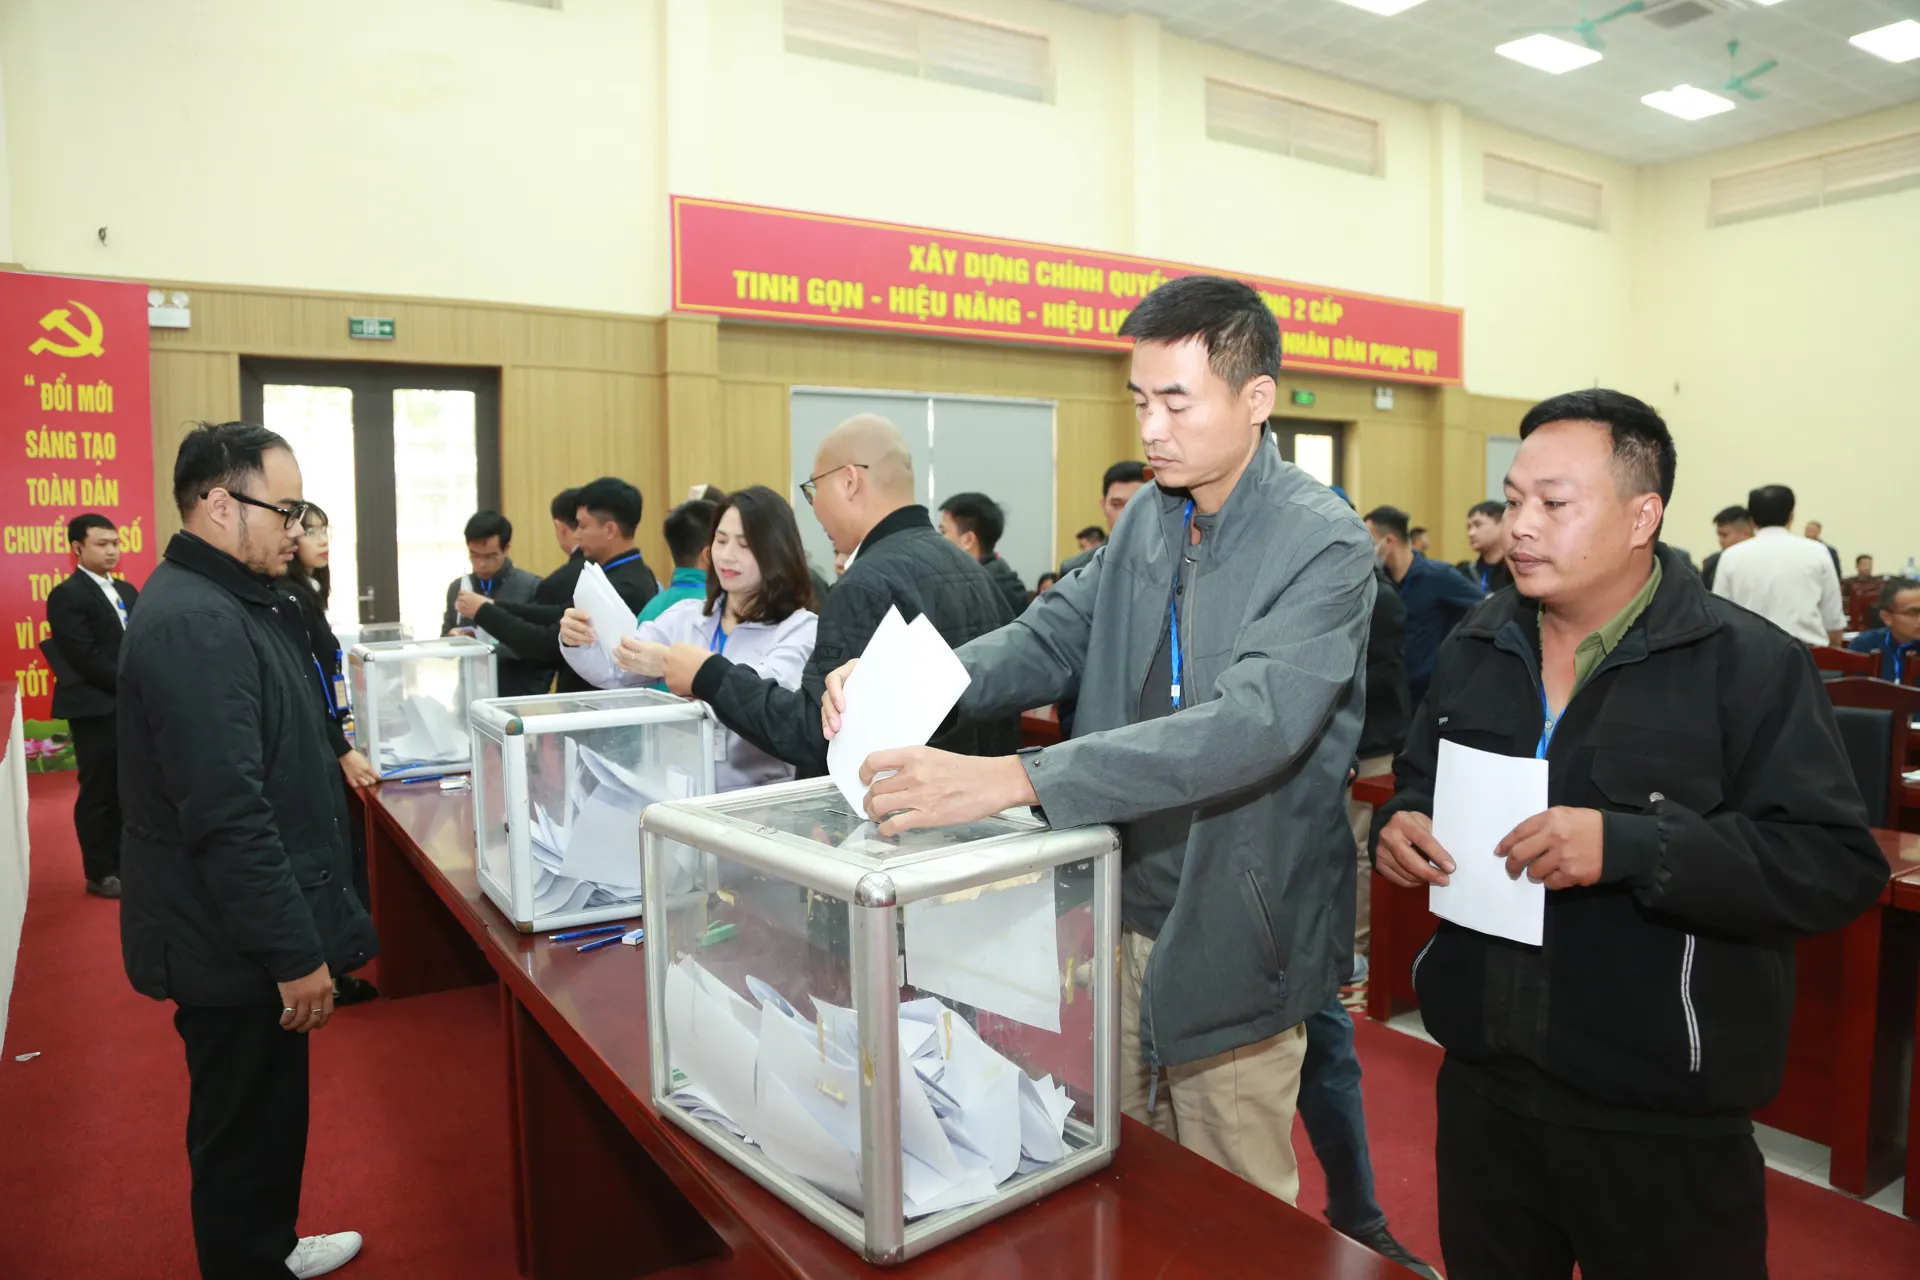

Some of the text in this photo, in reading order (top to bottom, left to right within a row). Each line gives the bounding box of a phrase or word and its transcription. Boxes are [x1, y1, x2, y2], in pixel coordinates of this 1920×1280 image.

[908, 241, 958, 276] XÂY
[963, 251, 1030, 287] DỰNG
[1035, 259, 1104, 293] CHÍNH
[1108, 267, 1174, 298] QUYỀ
[1293, 297, 1307, 321] 2
[1309, 295, 1344, 326] CẤP
[732, 269, 799, 304] TINH
[806, 277, 864, 313] GỌN
[871, 295, 882, 304] -
[888, 283, 947, 322] HIỆU
[953, 289, 1021, 326] NĂNG
[1026, 311, 1037, 320] -
[1042, 299, 1094, 336] HIỆU
[1281, 330, 1330, 360] NHÂN
[1332, 335, 1368, 364] DÂN
[40, 372, 73, 412] ĐỔI
[77, 379, 114, 413] MỚI
[25, 424, 117, 466] SÁNG TẠO
[26, 472, 119, 507] TOÀN DÂN
[3, 515, 143, 554] CHUYỂ SỐ
[15, 616, 35, 649] VÌ
[15, 659, 49, 697] TỐT
